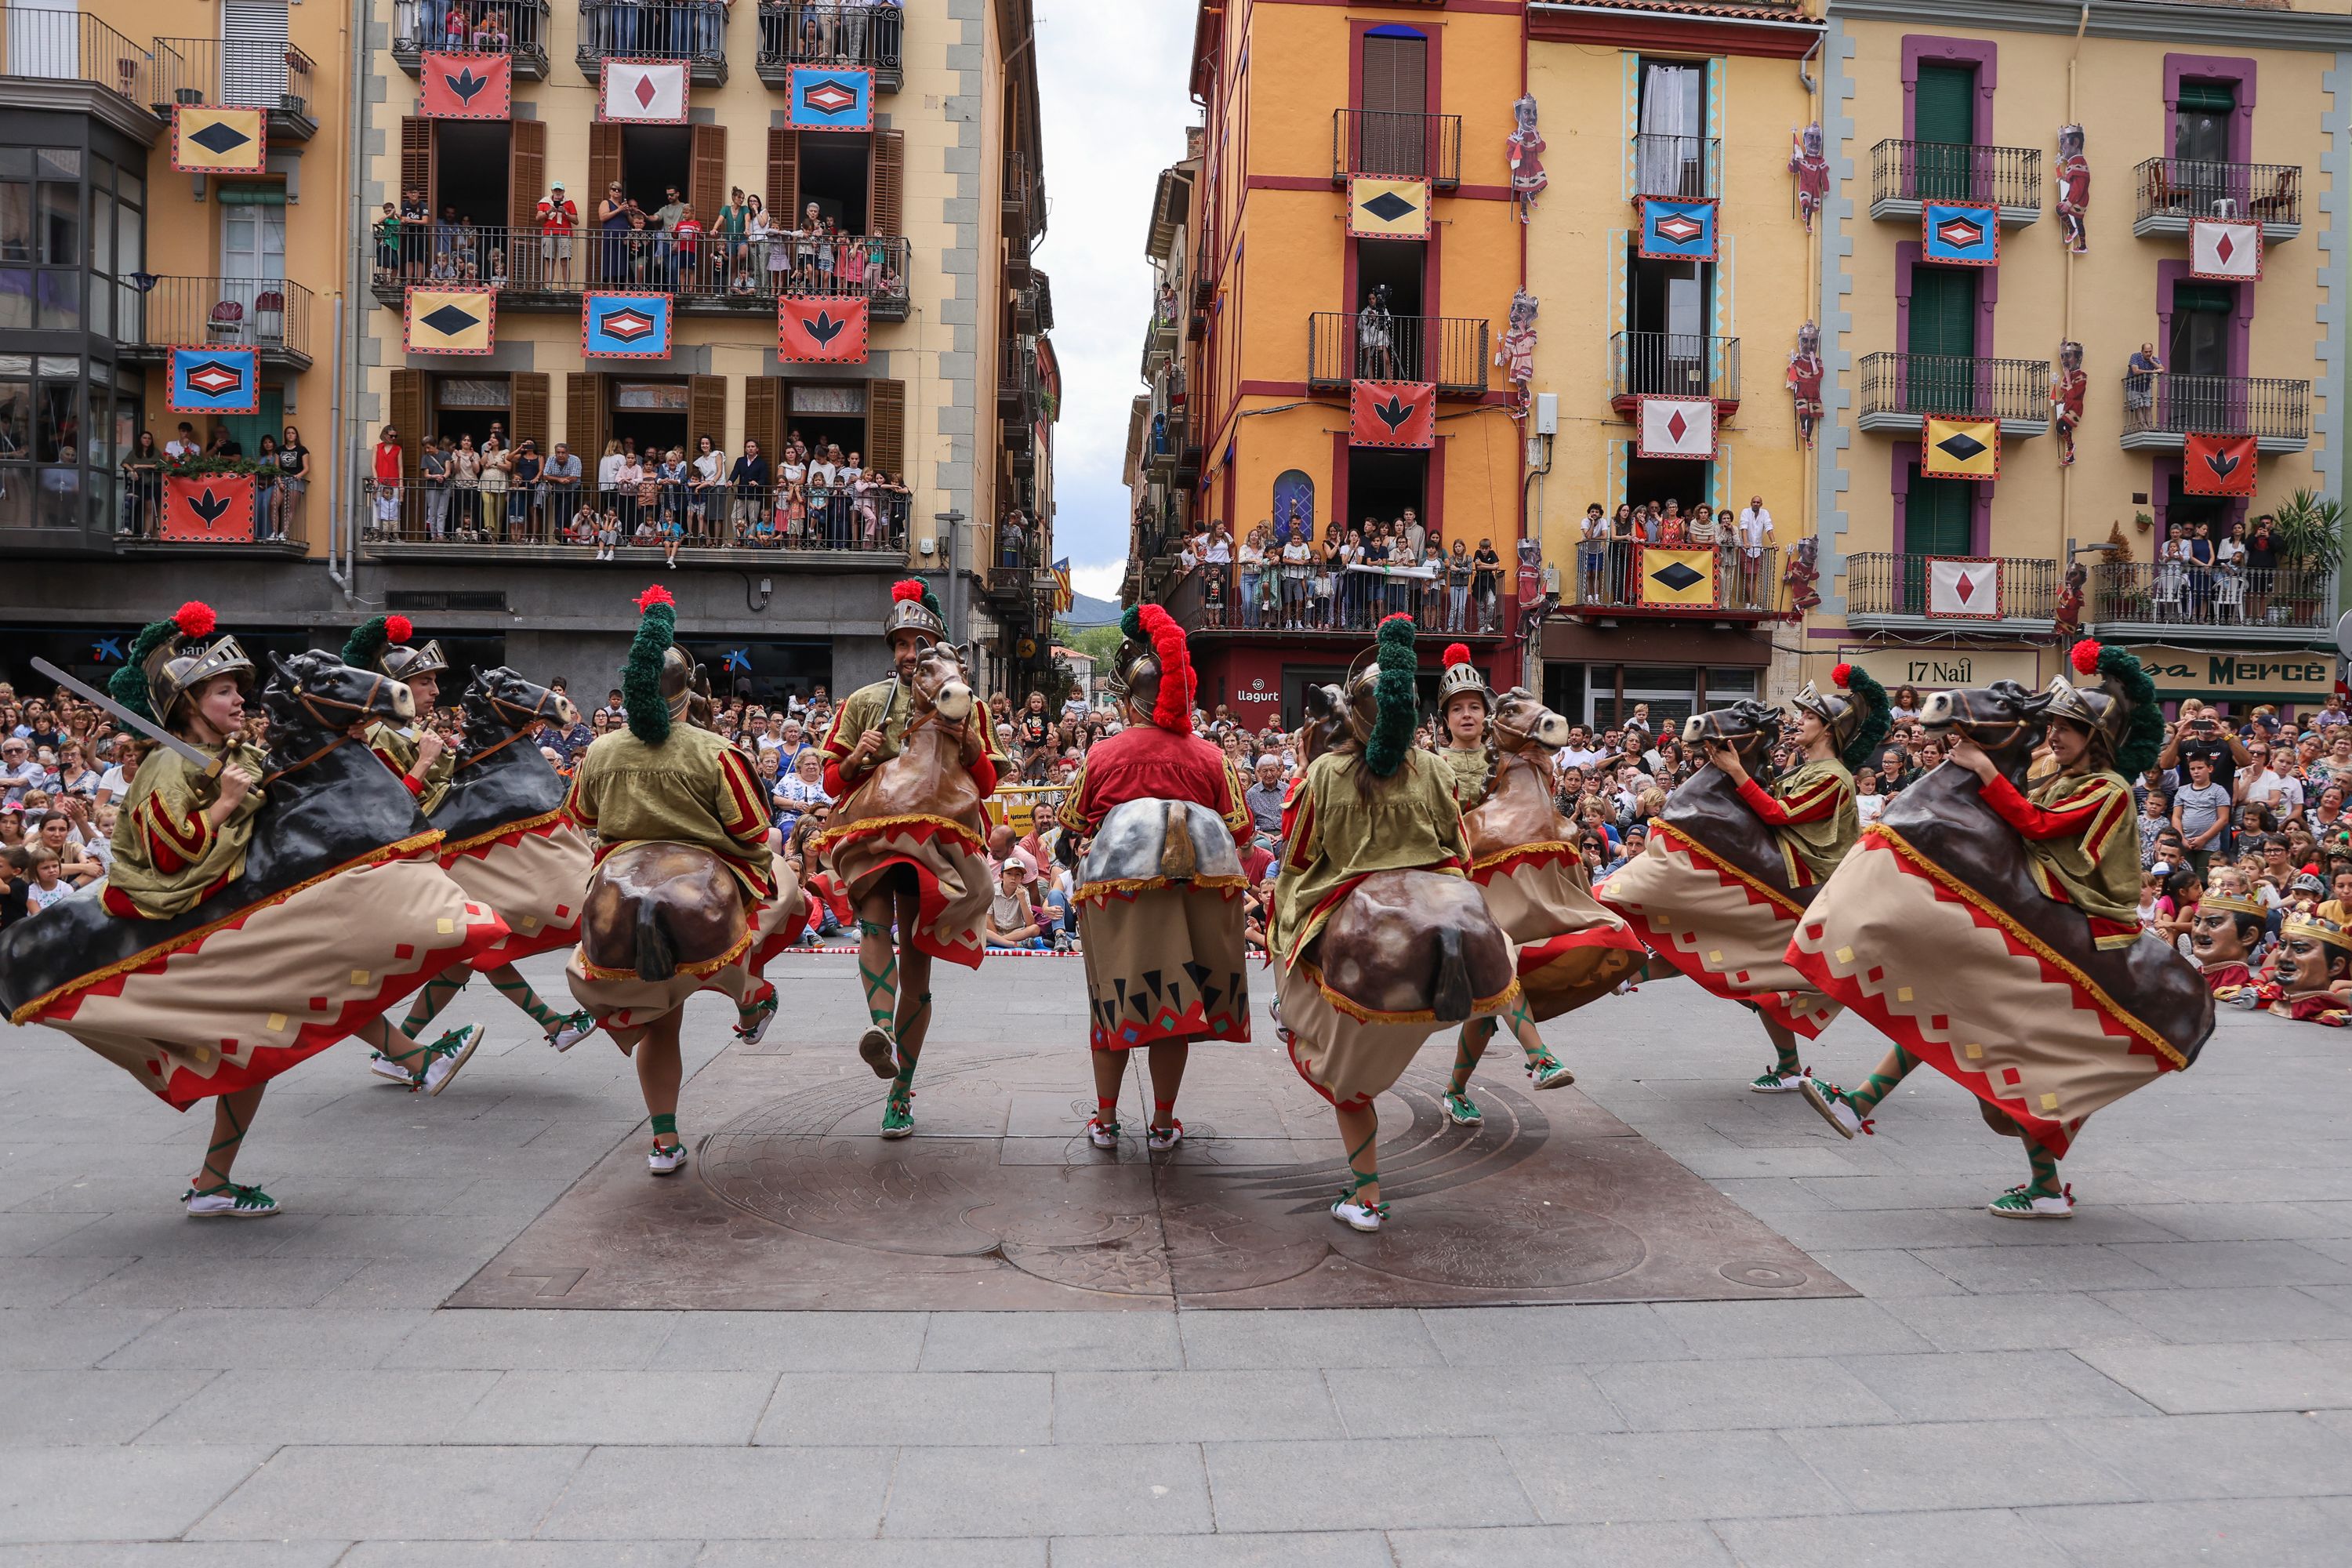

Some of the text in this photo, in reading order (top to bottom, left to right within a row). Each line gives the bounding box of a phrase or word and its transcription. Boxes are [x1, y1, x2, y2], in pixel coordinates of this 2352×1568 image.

[1907, 658, 1972, 682] 17 Nail
[2141, 656, 2326, 684] sa Mercè
[1238, 690, 1279, 702] llagurt
[1777, 686, 1784, 695] 16
